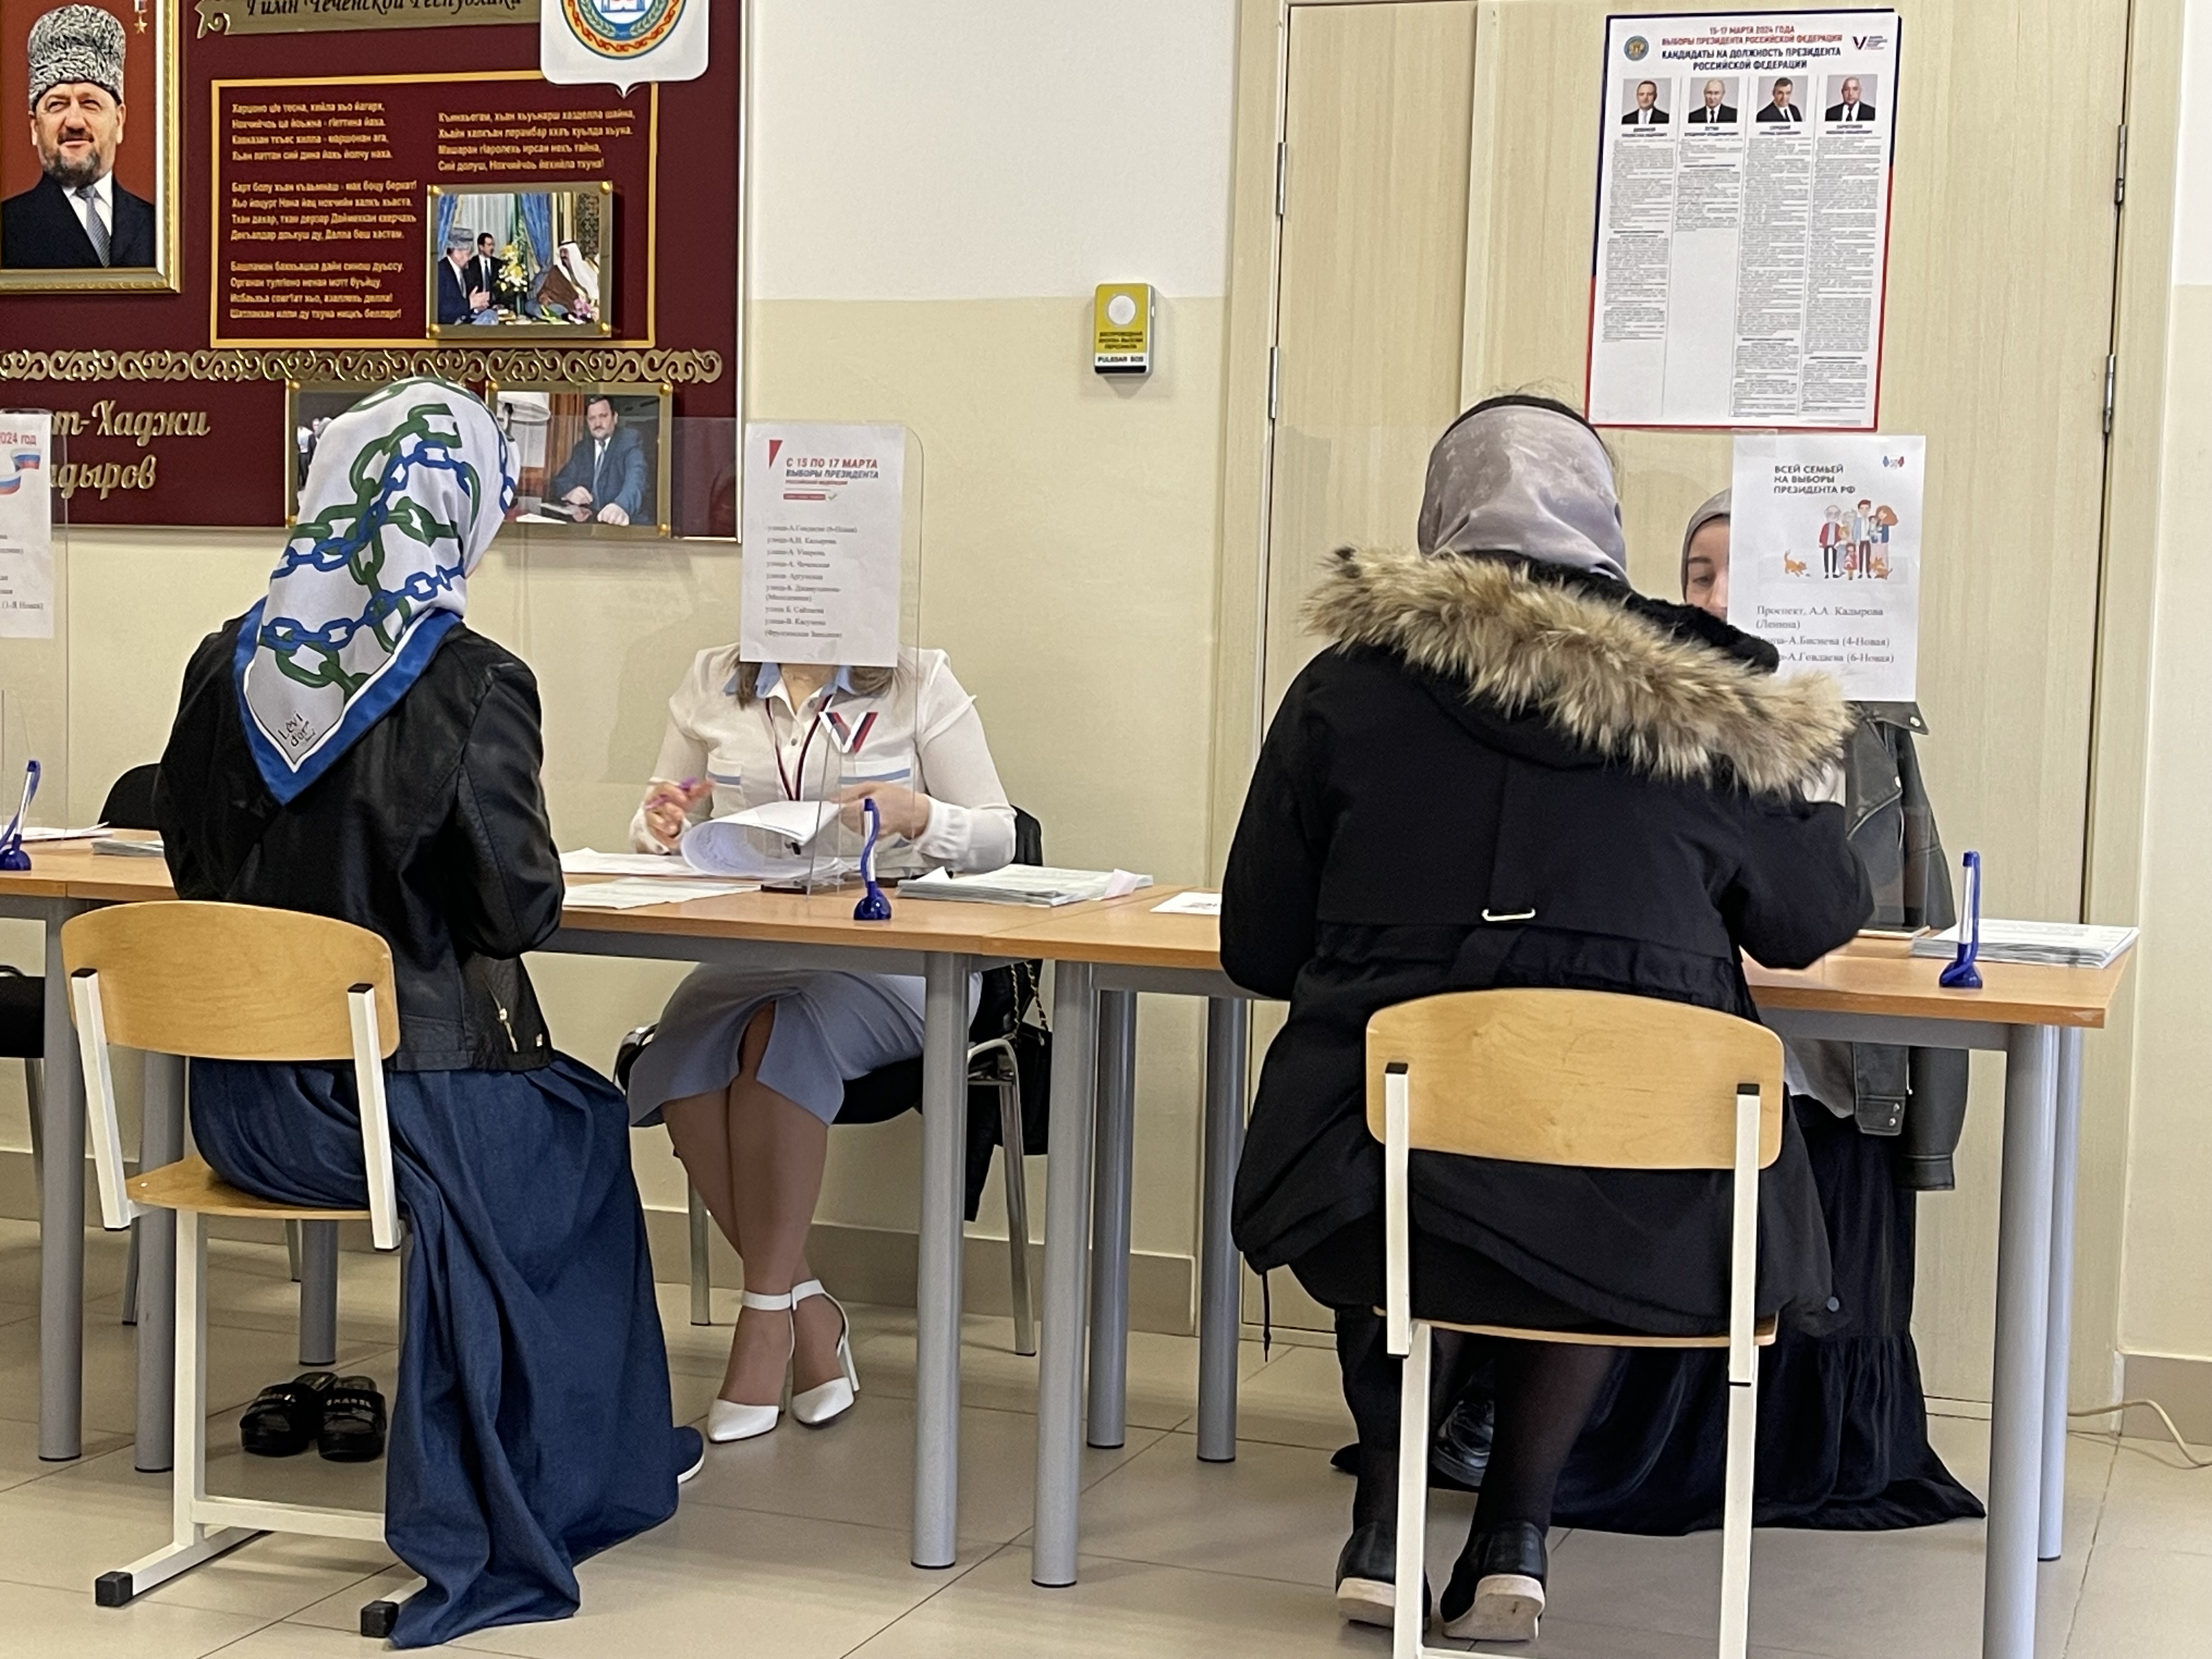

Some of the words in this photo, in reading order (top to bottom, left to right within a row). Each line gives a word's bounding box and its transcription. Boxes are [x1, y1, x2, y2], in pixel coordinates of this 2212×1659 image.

[786, 458, 793, 467] С
[797, 458, 808, 467] 15
[810, 458, 825, 467] ПО
[829, 459, 840, 468] 17
[842, 459, 878, 469] МАРТА
[1774, 464, 1801, 473] ВСЕЙ
[1803, 464, 1844, 474] СЕМЬЕЙ
[824, 470, 879, 479] ПРЕЗИДЕНТА
[1774, 486, 1838, 494] ПРЕЗИДЕНТА
